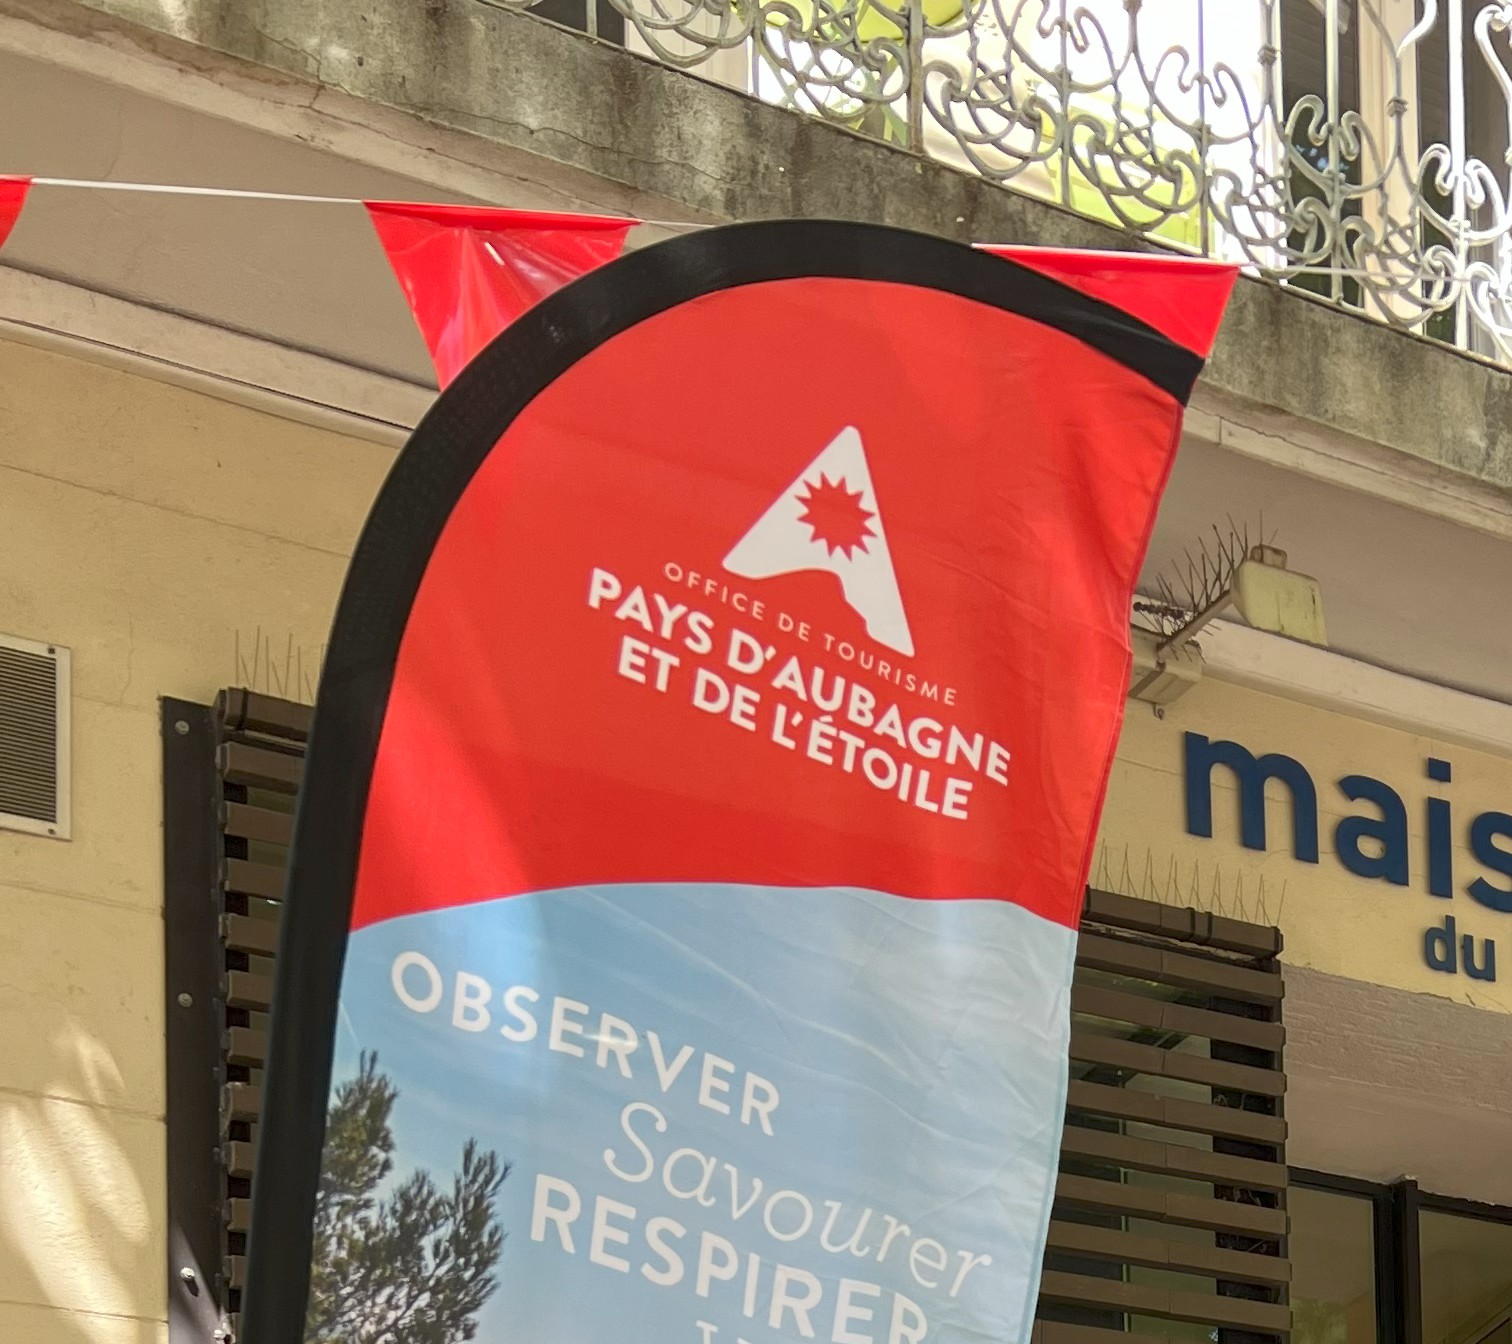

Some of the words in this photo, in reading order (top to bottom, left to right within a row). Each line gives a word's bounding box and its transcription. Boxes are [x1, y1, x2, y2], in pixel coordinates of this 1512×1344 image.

[588, 567, 714, 655] PAYS
[726, 629, 1011, 786] D'AUBAGNE
[664, 562, 765, 620] OFFICE
[777, 613, 811, 641] DE
[823, 633, 957, 706] TOURISME
[618, 635, 680, 692] ET
[693, 667, 760, 732] DE
[772, 703, 973, 820] L'ÉTOILE
[1424, 913, 1497, 983] du
[391, 950, 780, 1137] OBSERVER
[603, 1102, 993, 1298] Savourer
